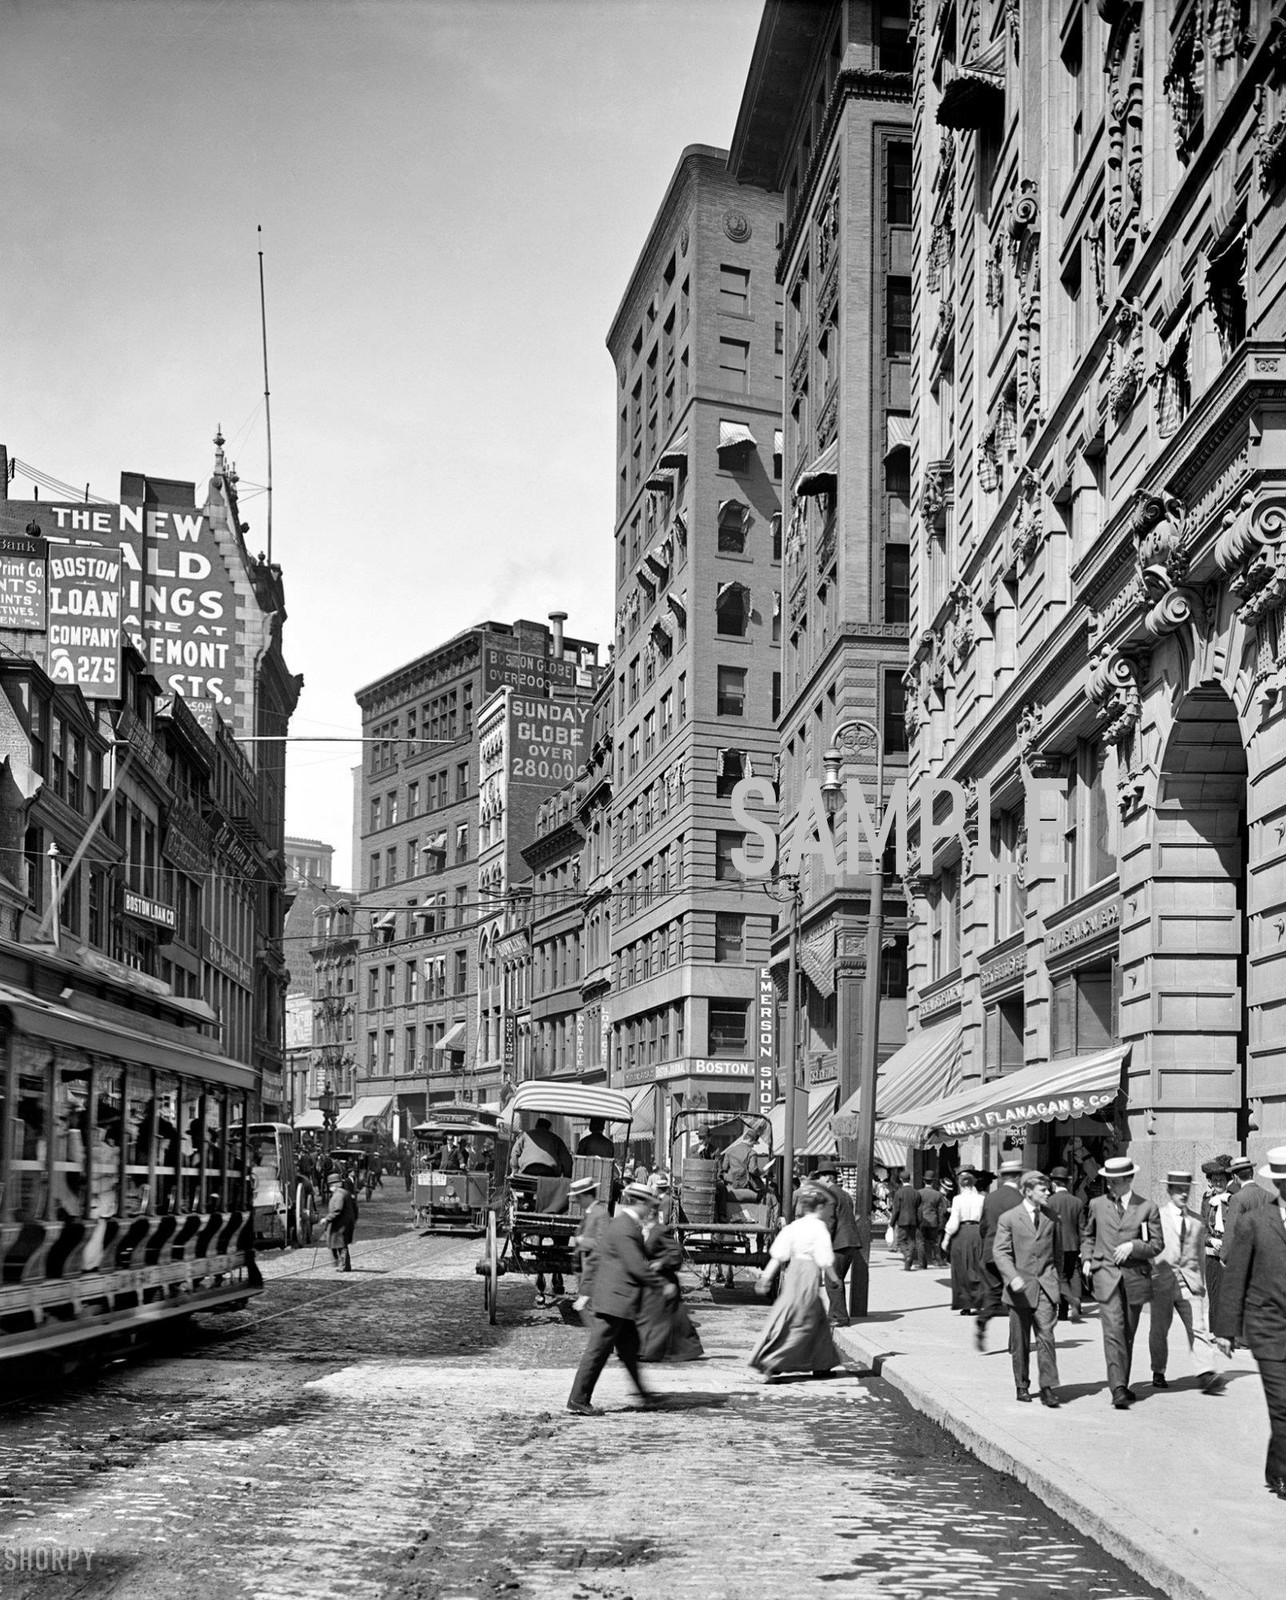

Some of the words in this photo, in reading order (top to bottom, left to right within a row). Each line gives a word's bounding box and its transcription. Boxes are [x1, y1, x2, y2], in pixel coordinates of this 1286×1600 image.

[52, 507, 112, 533] THE
[119, 504, 204, 543] NEW
[0, 561, 24, 576] rint
[28, 561, 44, 577] Co.
[51, 557, 119, 583] BOSTON
[50, 587, 119, 618] LOAN
[122, 580, 224, 620] INGS
[51, 625, 119, 648] COMPANY
[122, 614, 182, 633] ARE
[192, 625, 228, 637] AT
[78, 656, 116, 684] 275
[490, 651, 534, 670] BOSTON
[537, 660, 571, 678] GLOBE
[490, 669, 518, 684] OVER
[512, 701, 590, 723] SUNDAY
[518, 722, 584, 747] GLOBE
[528, 745, 573, 760] OVER
[126, 894, 150, 917] BOSTON
[151, 903, 166, 923] LOAN
[760, 968, 772, 1057] EMERSON
[696, 1060, 748, 1074] BOSTON
[943, 1122, 968, 1136] WM.
[970, 1116, 985, 1130] J.
[985, 1099, 1071, 1126] FLANAGAN
[1072, 1096, 1085, 1109] &
